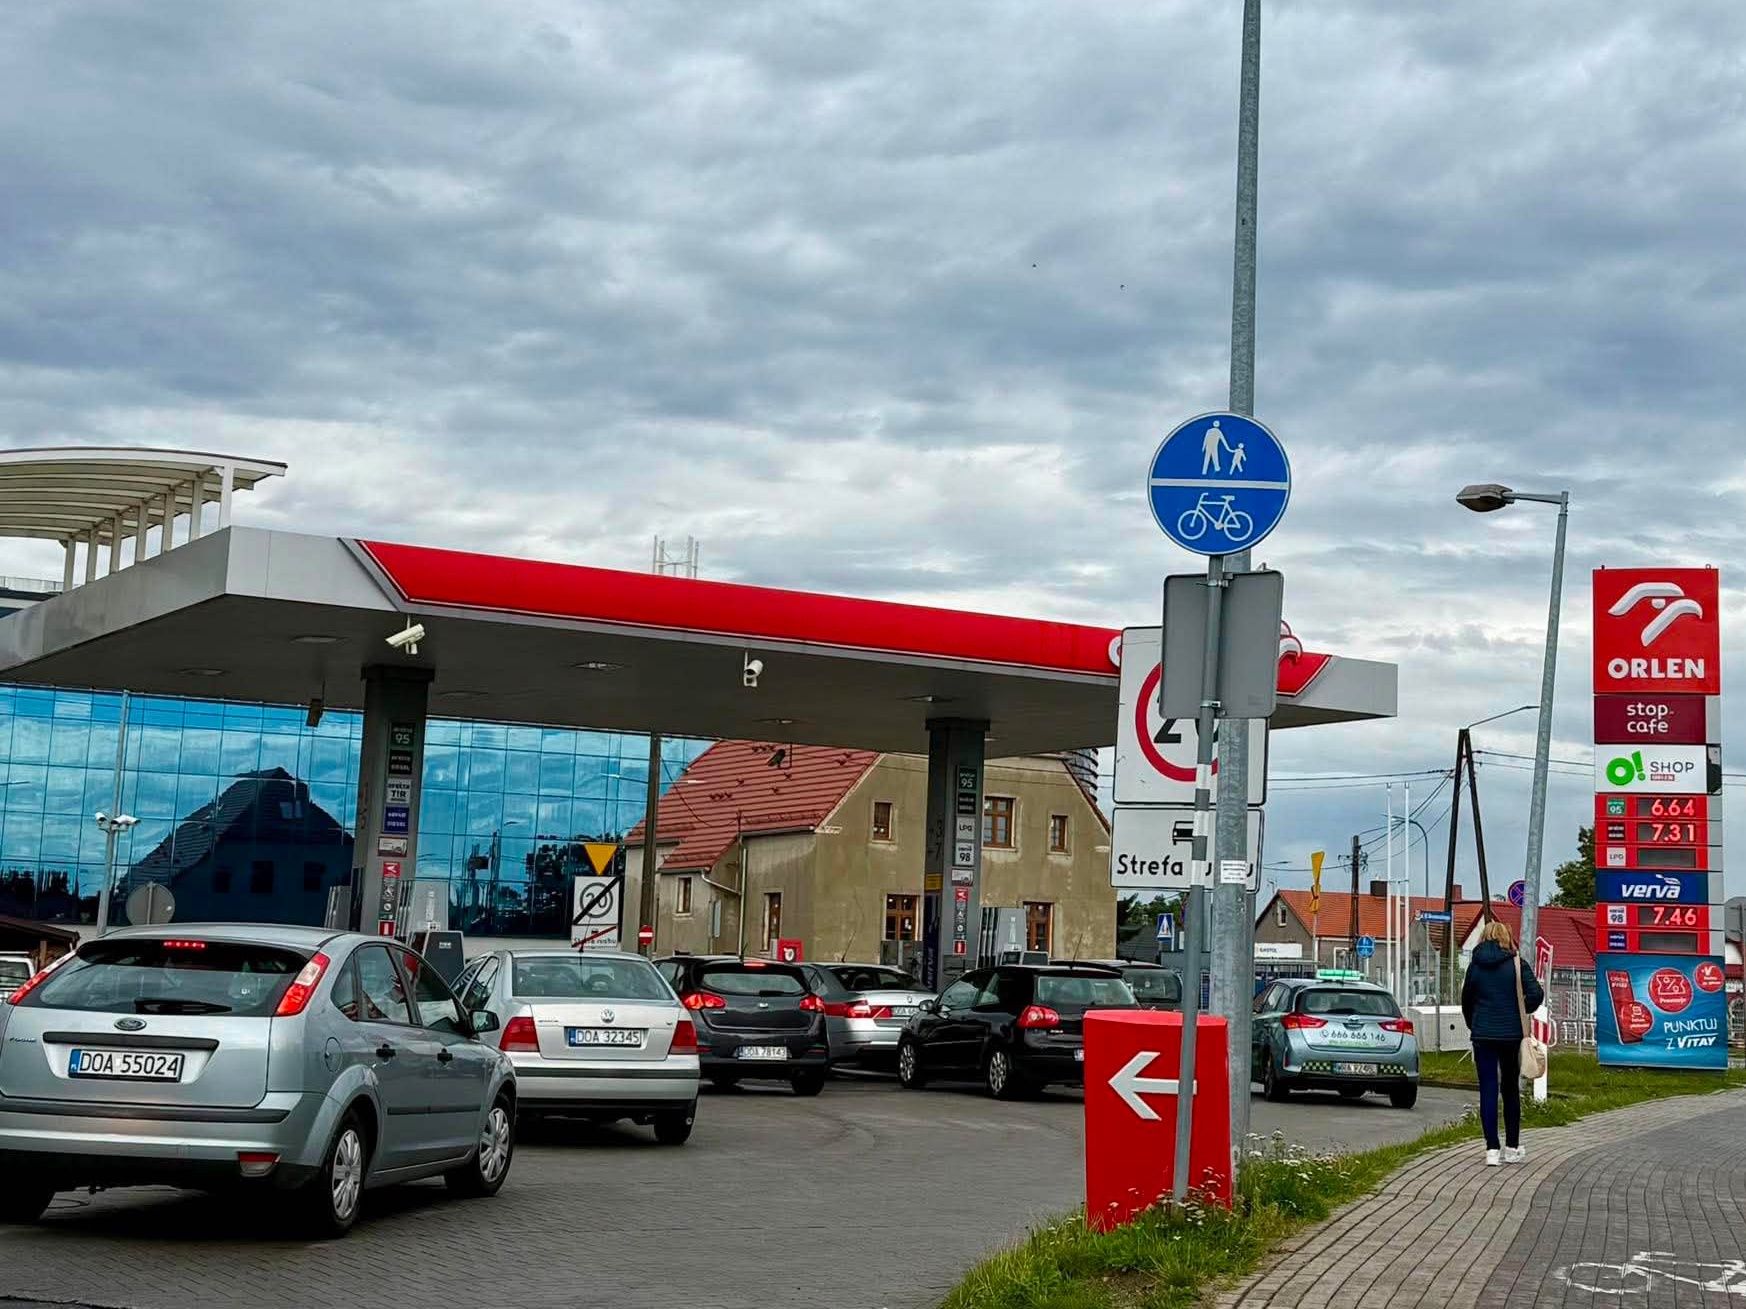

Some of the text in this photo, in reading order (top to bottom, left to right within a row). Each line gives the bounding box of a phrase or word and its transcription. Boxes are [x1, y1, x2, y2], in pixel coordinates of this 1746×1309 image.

[1607, 658, 1705, 679] ORLEN
[1626, 702, 1669, 720] stop
[1627, 719, 1669, 734] cafe
[395, 733, 410, 744] 95
[1650, 761, 1695, 773] SHOP
[961, 778, 973, 788] 95
[1652, 799, 1695, 816] 6.64
[1652, 824, 1695, 841] 7.31
[960, 852, 971, 861] 98
[1609, 852, 1624, 860] LPG
[1117, 854, 1183, 875] Strefa
[1622, 882, 1681, 899] verva
[1610, 914, 1624, 923] 98
[1653, 907, 1697, 925] 7.46
[1663, 1018, 1718, 1033] PUNKTUJ
[576, 1030, 640, 1043] DOA 32345
[1350, 1032, 1368, 1040] 666
[1370, 1032, 1386, 1041] 146
[80, 1053, 179, 1076] DOA 55024
